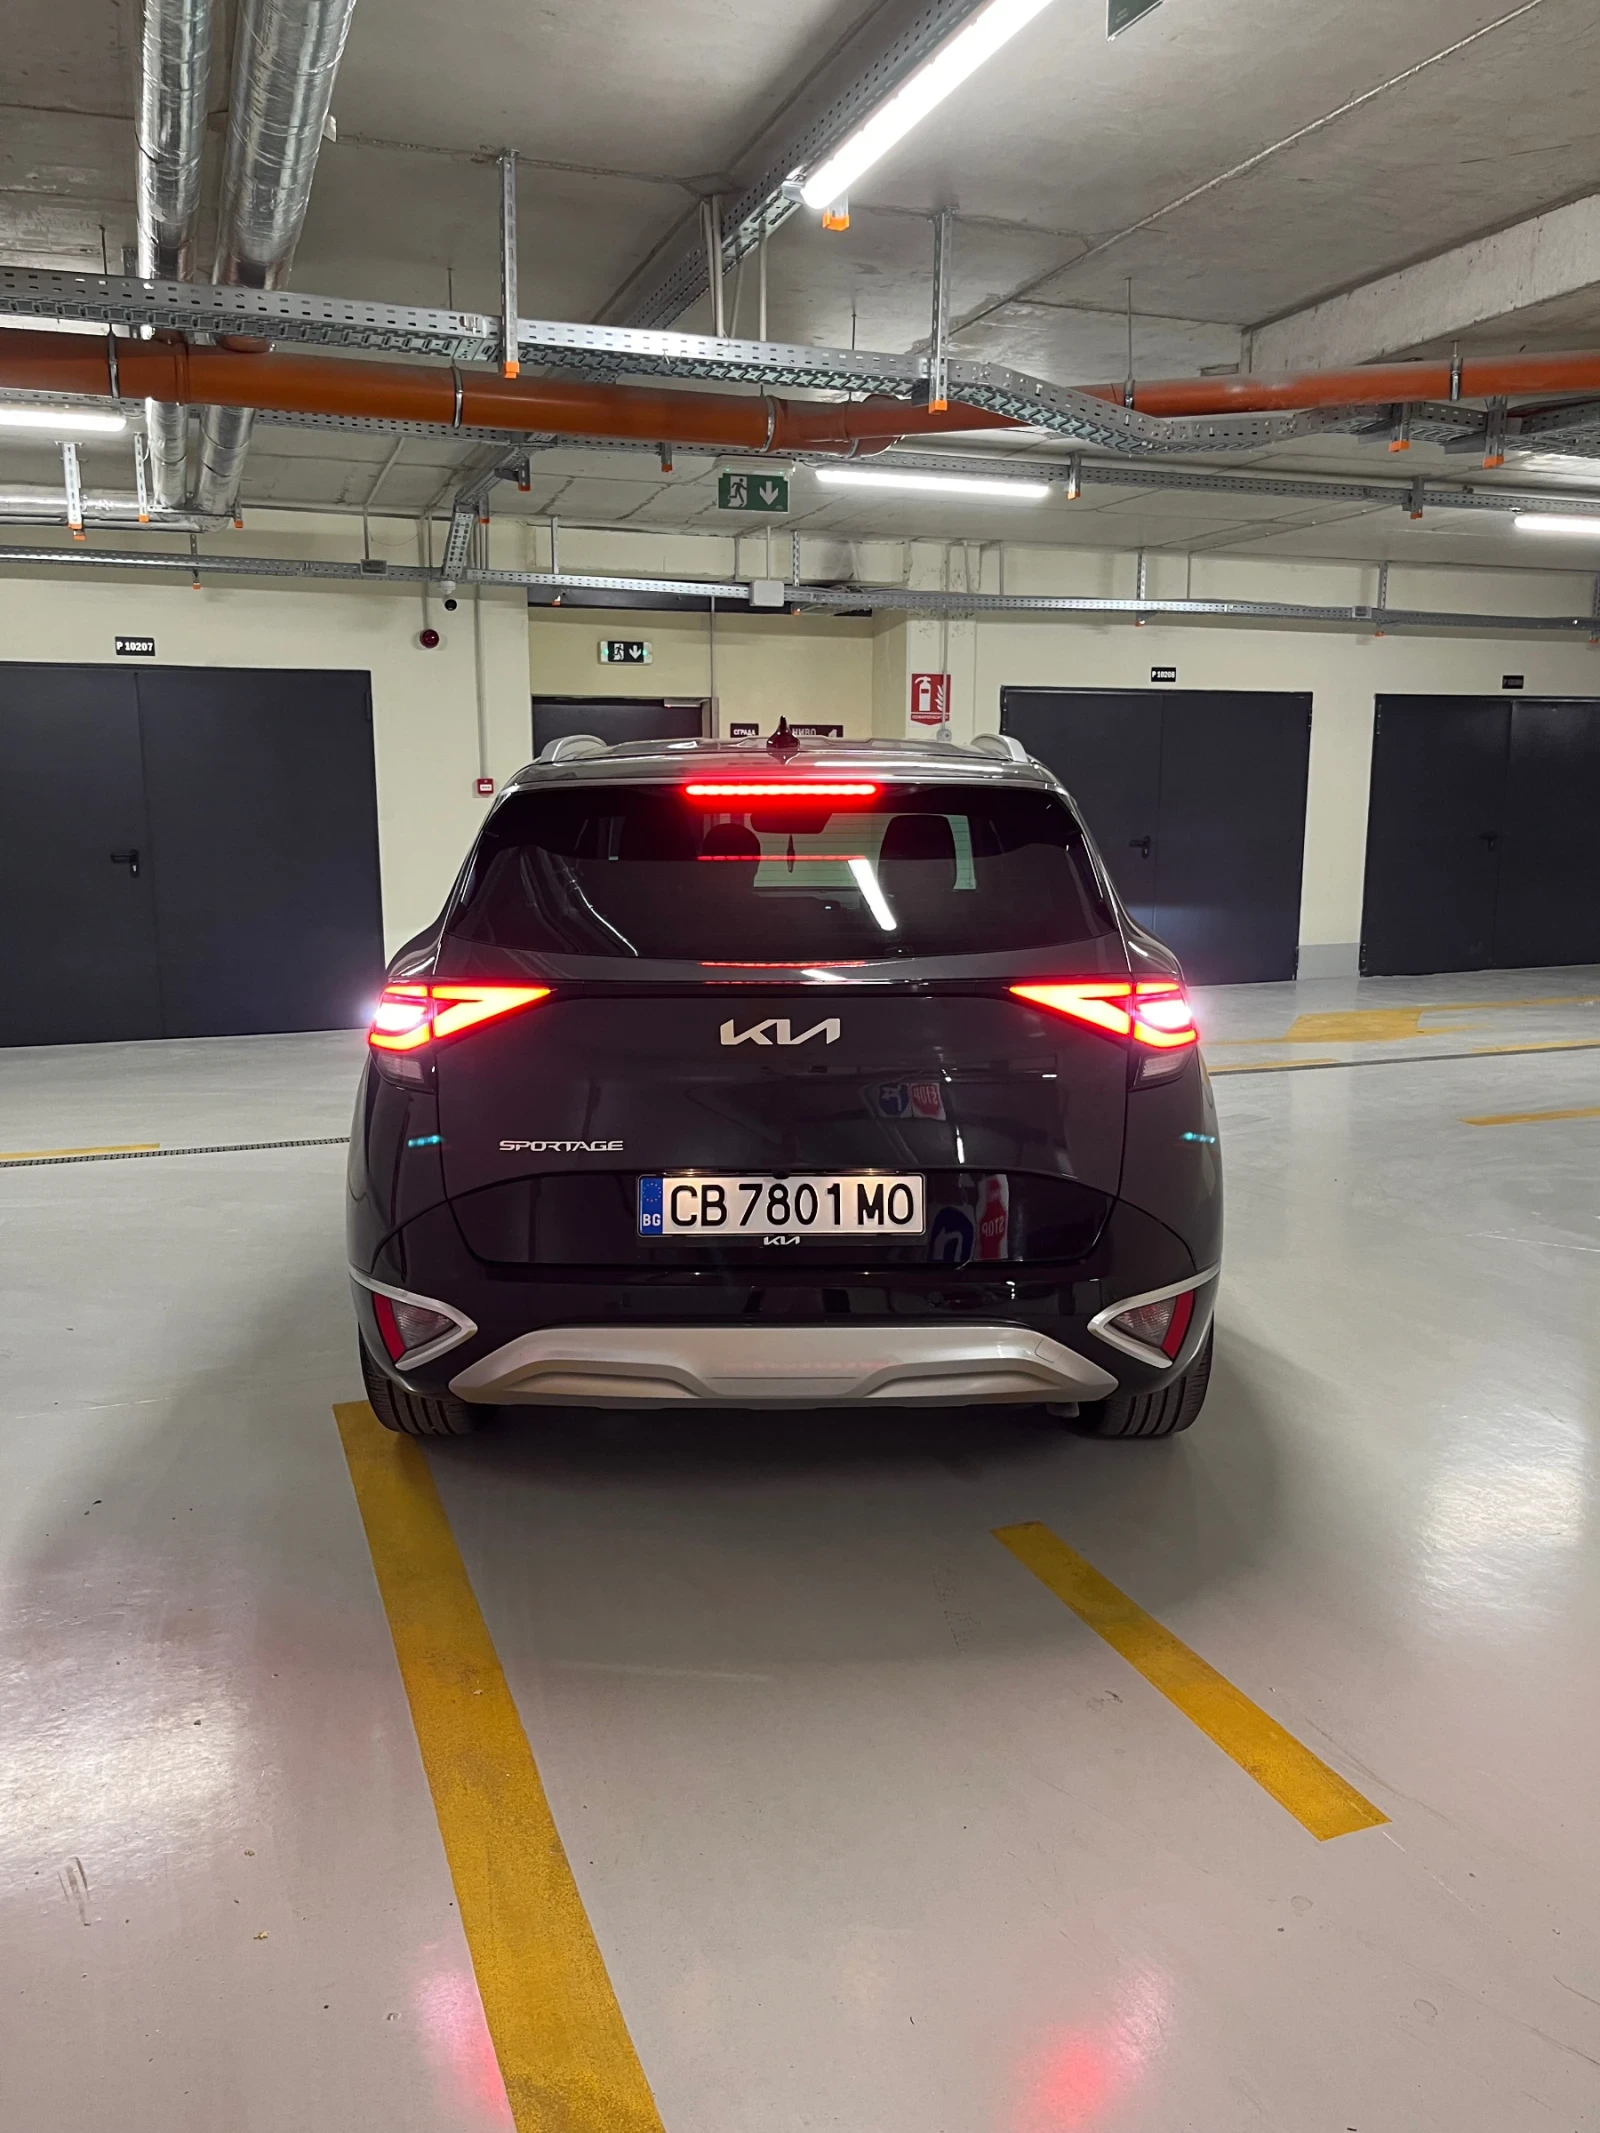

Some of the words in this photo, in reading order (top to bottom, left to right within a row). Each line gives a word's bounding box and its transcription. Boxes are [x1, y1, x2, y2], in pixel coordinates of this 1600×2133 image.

[116, 641, 123, 650] P
[125, 641, 153, 651] 10207
[720, 1018, 841, 1045] KIA
[499, 1140, 624, 1152] SPORTAGE
[671, 1183, 728, 1226] CB
[738, 1182, 842, 1226] 7801
[857, 1182, 914, 1226] MO
[643, 1213, 661, 1226] BG
[763, 1236, 800, 1245] KIA
